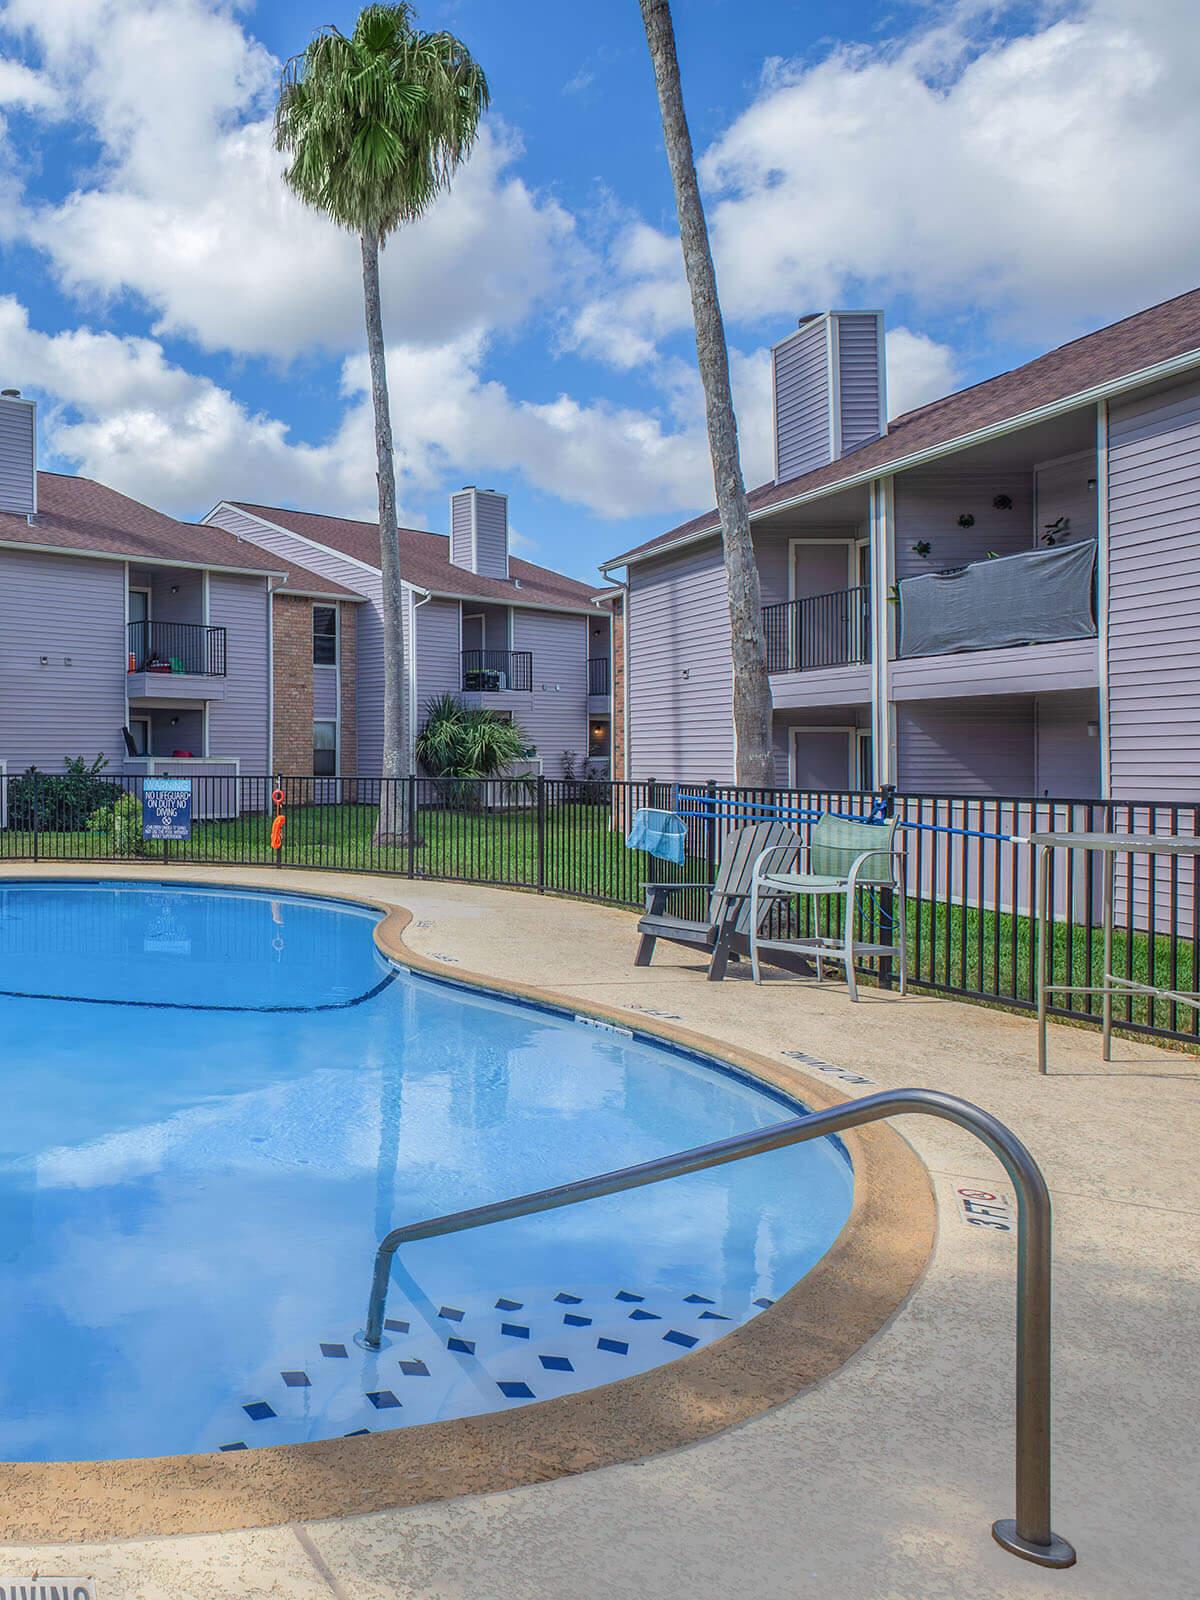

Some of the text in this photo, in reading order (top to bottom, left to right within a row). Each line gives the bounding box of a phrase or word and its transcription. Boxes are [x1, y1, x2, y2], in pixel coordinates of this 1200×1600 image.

[145, 792, 155, 800] NO
[147, 800, 187, 808] ON DUTY NO
[156, 808, 177, 816] DIVING
